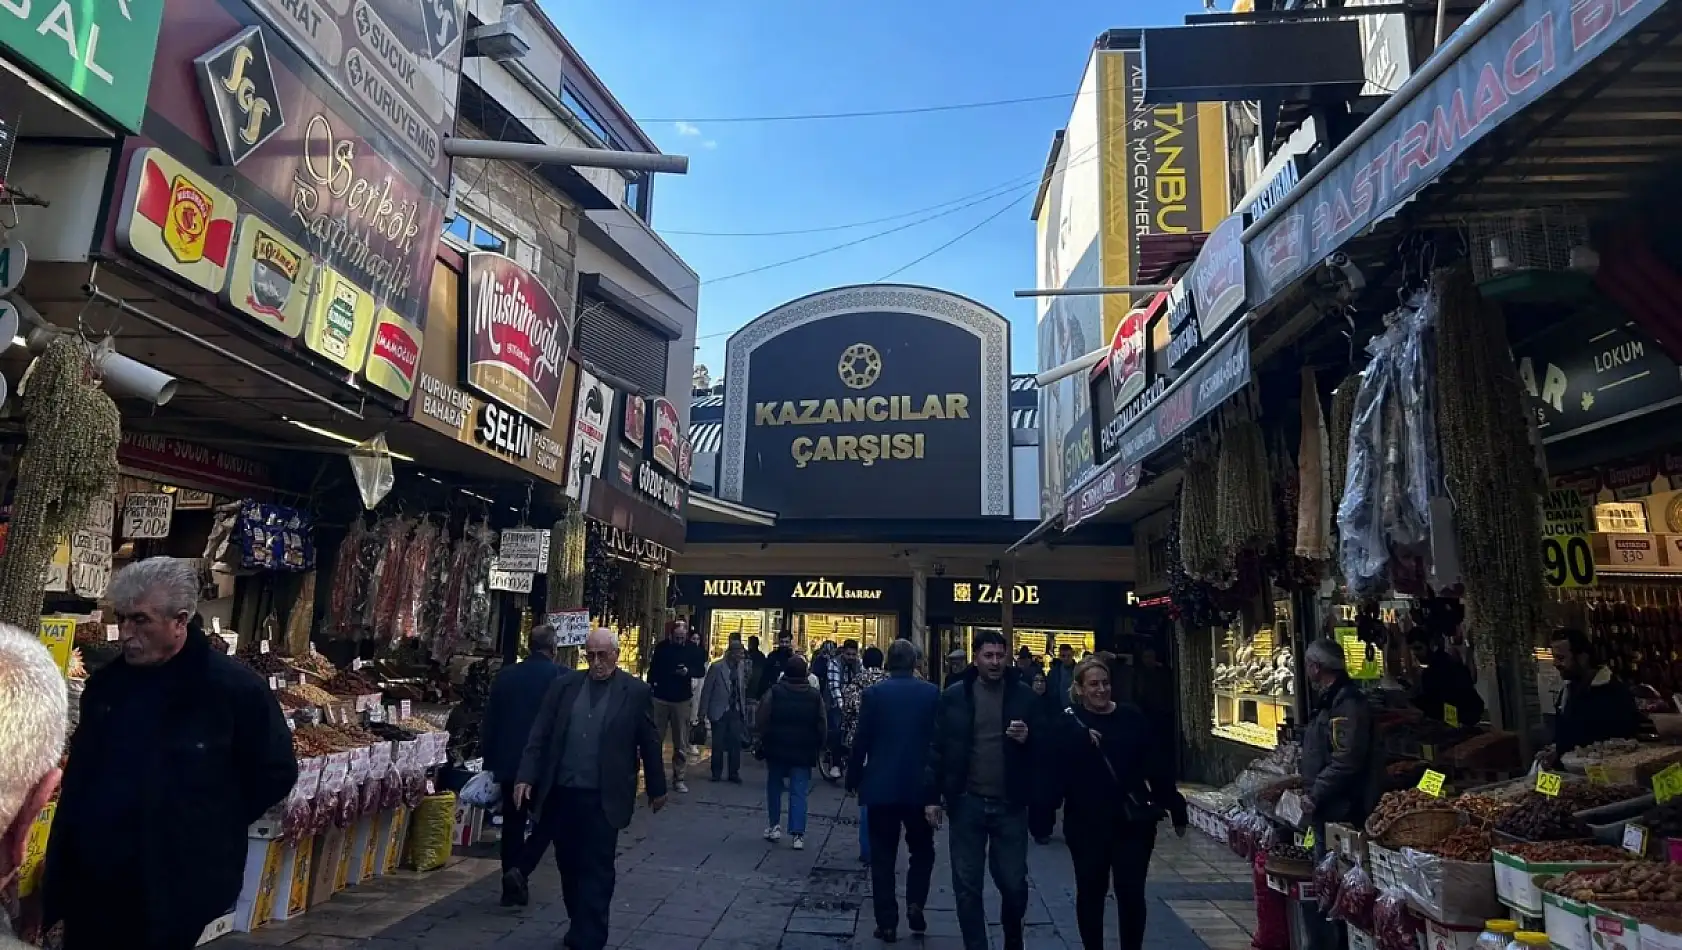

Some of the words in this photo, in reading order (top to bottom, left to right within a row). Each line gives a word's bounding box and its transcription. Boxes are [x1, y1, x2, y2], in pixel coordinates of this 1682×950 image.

[369, 25, 416, 90] SUCUK
[1593, 340, 1644, 374] LOKUM
[423, 396, 467, 430] BAHARAT
[755, 393, 971, 426] KAZANCILAR
[483, 402, 533, 458] SELİN
[791, 433, 926, 468] ÇARŞISI
[703, 579, 766, 598] MURAT
[791, 575, 844, 599] AZİM
[844, 588, 883, 600] SARRAF
[978, 583, 1041, 605] ZADE
